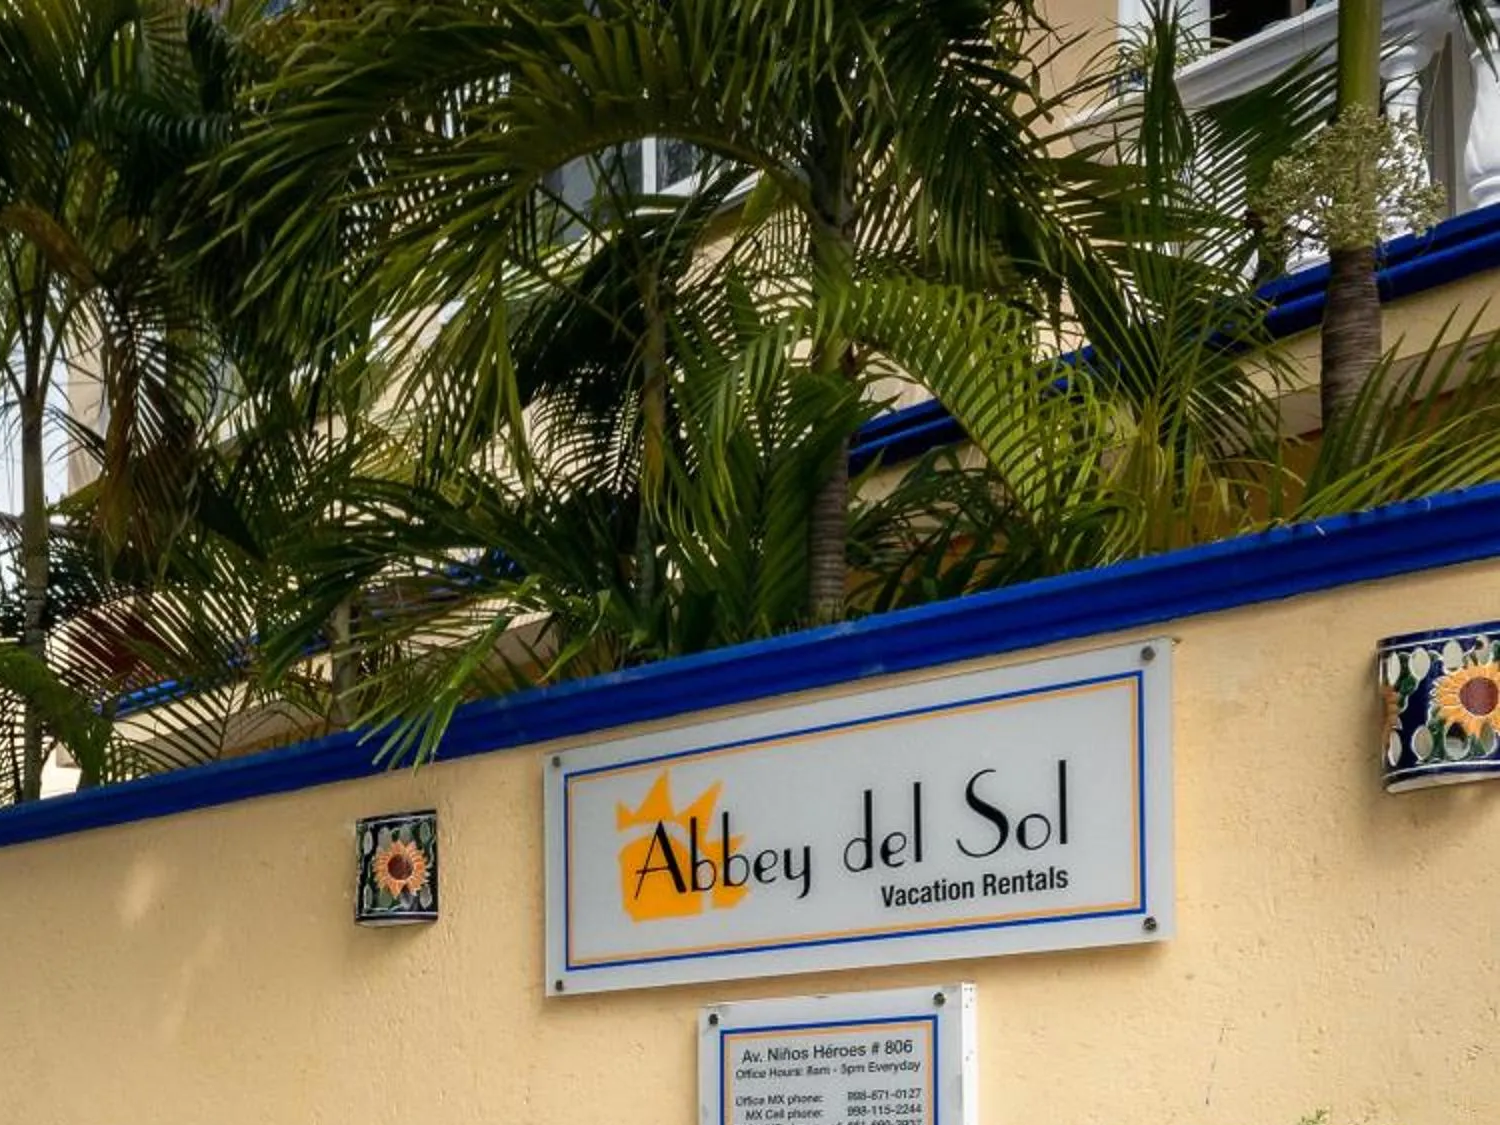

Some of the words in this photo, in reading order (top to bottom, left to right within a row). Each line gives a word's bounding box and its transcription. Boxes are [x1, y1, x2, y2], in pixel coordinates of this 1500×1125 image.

[634, 811, 812, 900] Abbey
[843, 781, 922, 873] del
[956, 758, 1069, 859] Sol
[880, 879, 975, 908] Vacation
[981, 866, 1069, 898] Rentals
[741, 1049, 763, 1064] Av.
[813, 1043, 867, 1059] Héroes
[871, 1042, 880, 1056] #
[885, 1039, 914, 1055] 806
[735, 1068, 767, 1080] Office
[769, 1067, 802, 1078] Hours:
[841, 1062, 865, 1076] 5pm
[868, 1060, 921, 1075] Everyday
[735, 1095, 765, 1107] Office
[768, 1094, 785, 1105] MX
[787, 1093, 824, 1106] phone:
[745, 1109, 763, 1121] MX
[765, 1108, 785, 1120] Cell
[787, 1107, 824, 1121] phone:
